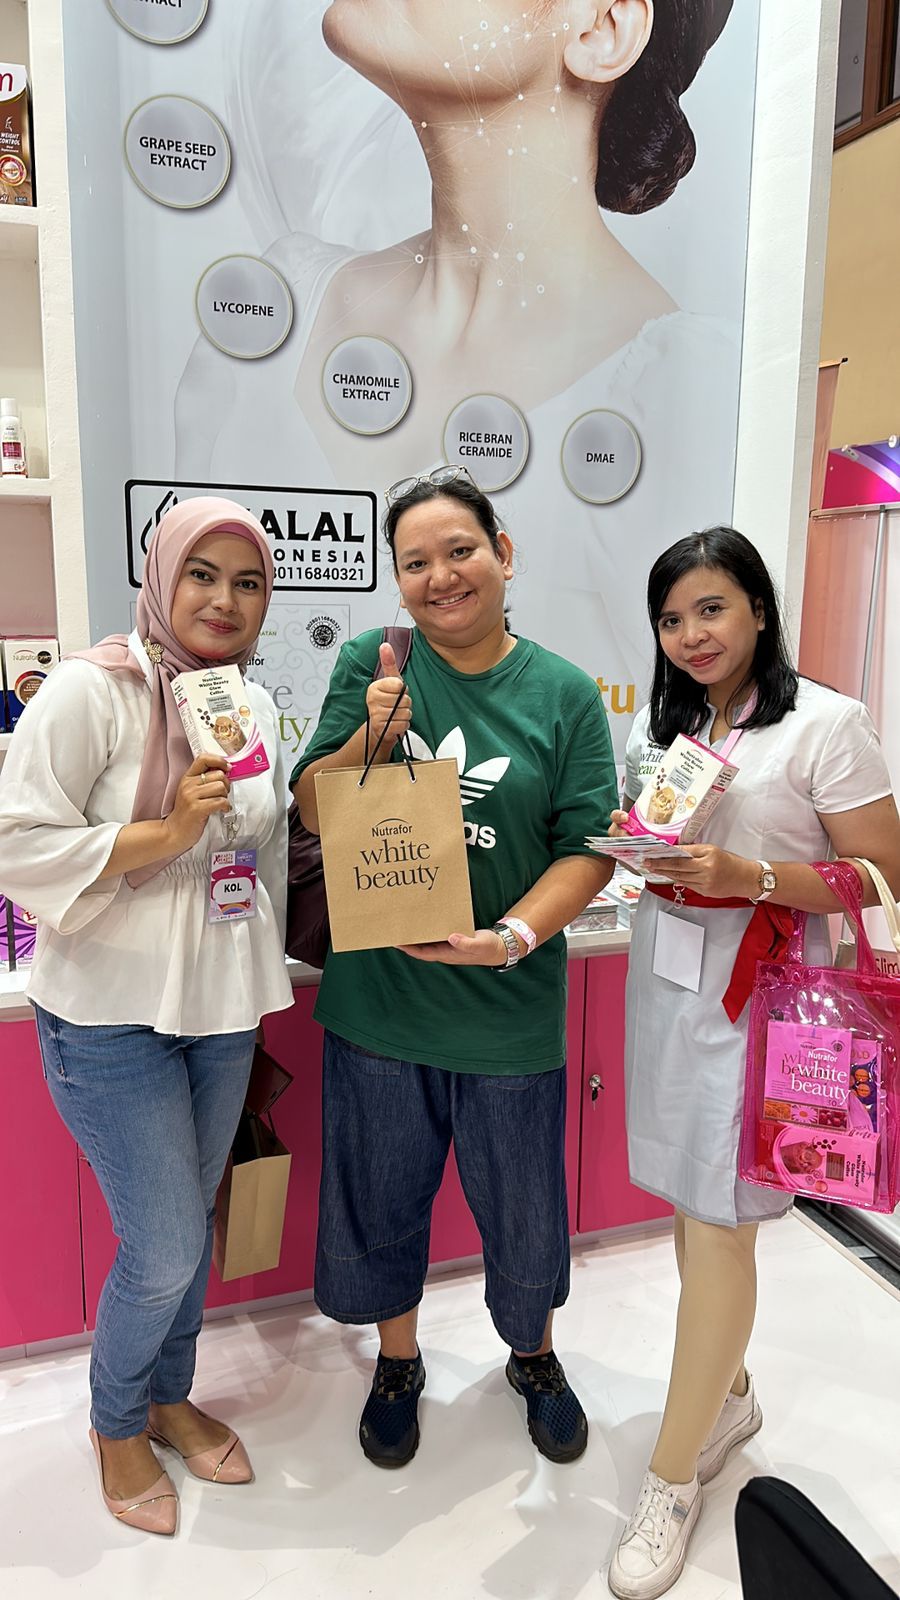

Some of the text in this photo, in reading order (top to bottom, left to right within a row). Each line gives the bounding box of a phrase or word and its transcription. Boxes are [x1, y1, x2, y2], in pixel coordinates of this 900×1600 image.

[139, 136, 217, 157] GRAPE SEED
[150, 153, 208, 171] EXTRACT
[213, 301, 274, 317] LYCOPENE
[332, 373, 400, 389] CHAMOMILE
[342, 388, 391, 402] EXTRACT
[459, 431, 513, 445] RICE BRAN
[458, 446, 513, 458] CERAMIDE
[586, 452, 615, 464] DMAE
[259, 509, 365, 543] ALAL
[371, 825, 413, 837] Nutrafor
[360, 839, 431, 866] white
[353, 864, 440, 891] beauty
[223, 882, 243, 893] KOL
[807, 1050, 838, 1063] Nutrafor
[797, 1060, 848, 1084] white
[790, 1073, 851, 1106] beauty
